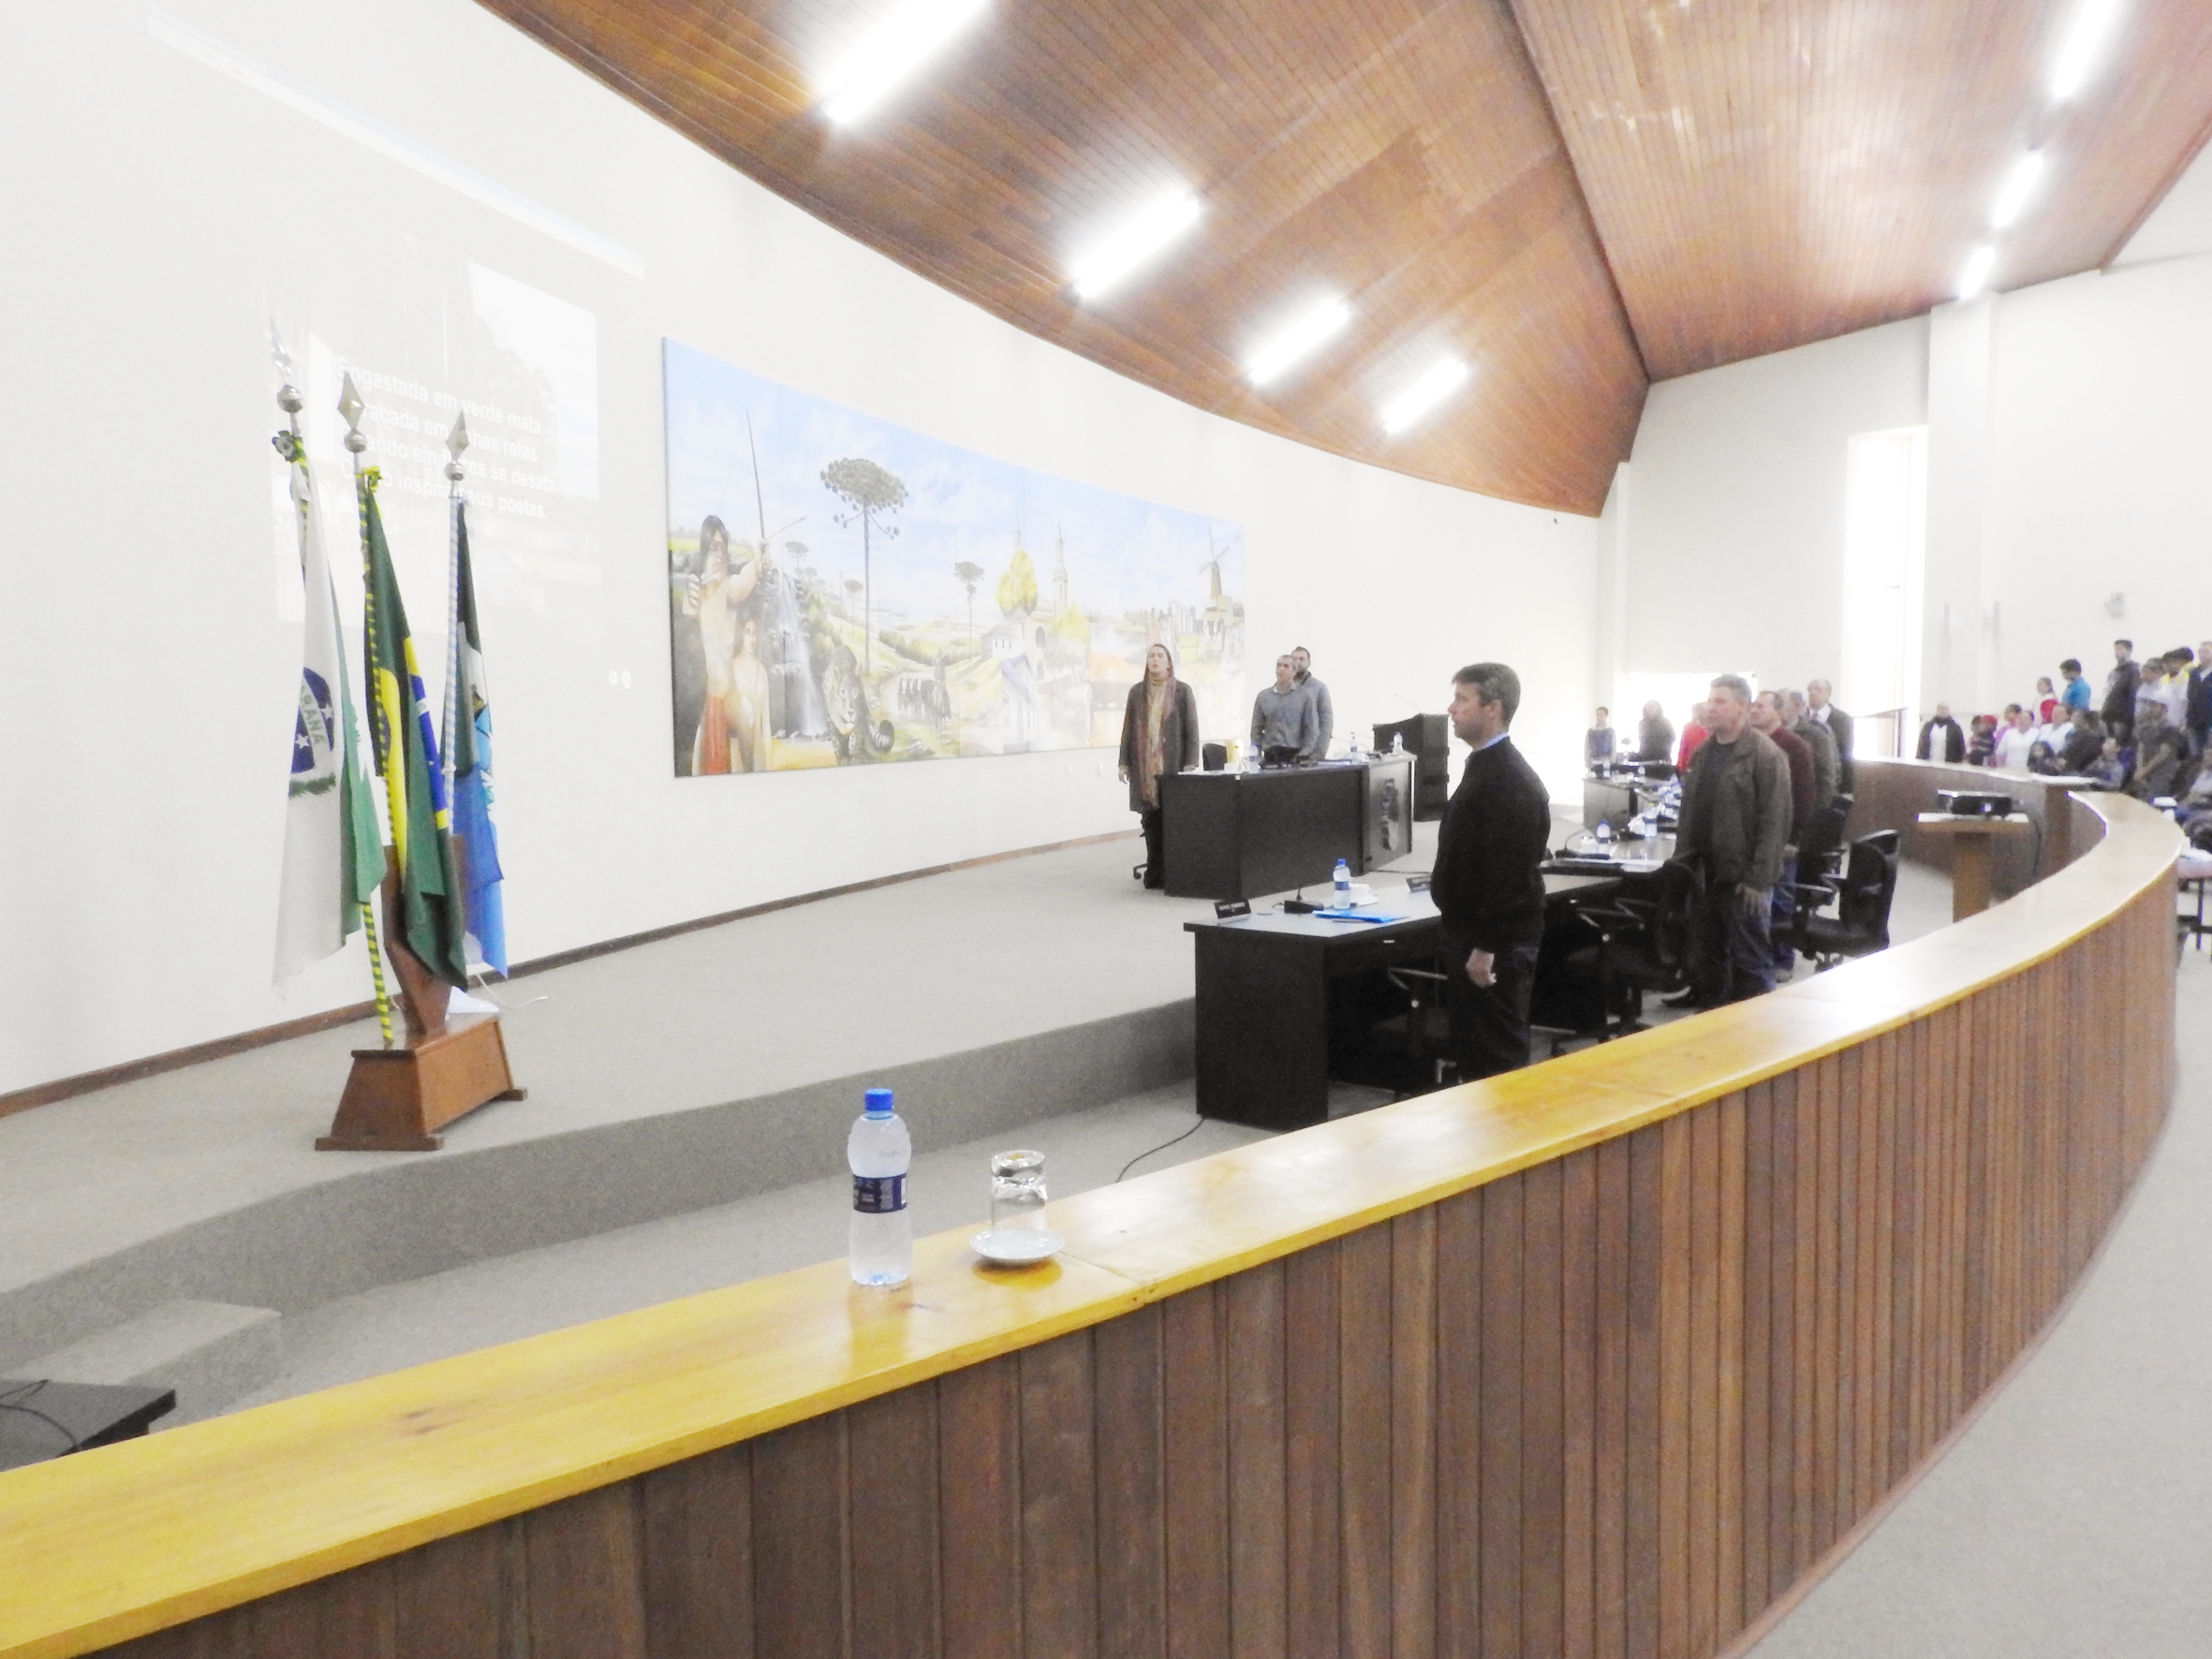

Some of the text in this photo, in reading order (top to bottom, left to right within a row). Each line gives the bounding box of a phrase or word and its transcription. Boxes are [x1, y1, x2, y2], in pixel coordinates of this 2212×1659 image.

[362, 403, 420, 433] raçada
[424, 419, 449, 440] em
[504, 439, 538, 462] retas
[433, 390, 458, 411] em
[462, 399, 504, 424] verde
[508, 413, 541, 435] mata
[413, 446, 437, 466] em
[491, 464, 508, 482] se
[511, 467, 556, 493] desata
[498, 496, 549, 519] poetas.
